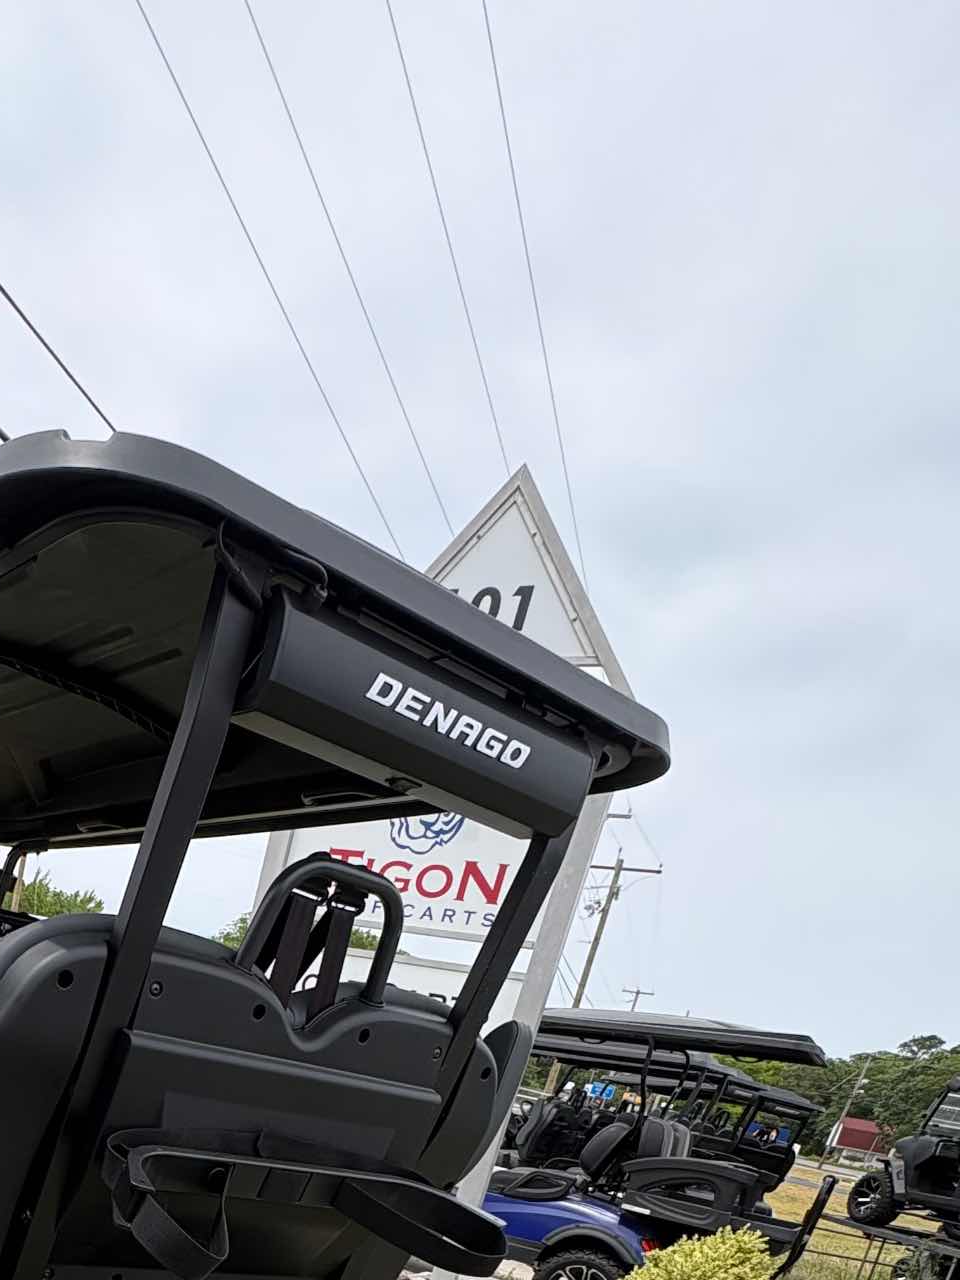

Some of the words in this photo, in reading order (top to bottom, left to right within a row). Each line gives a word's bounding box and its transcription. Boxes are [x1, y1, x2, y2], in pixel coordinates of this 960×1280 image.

[449, 584, 535, 632] 01
[365, 672, 531, 769] DENAGO
[403, 904, 495, 928] CARTS
